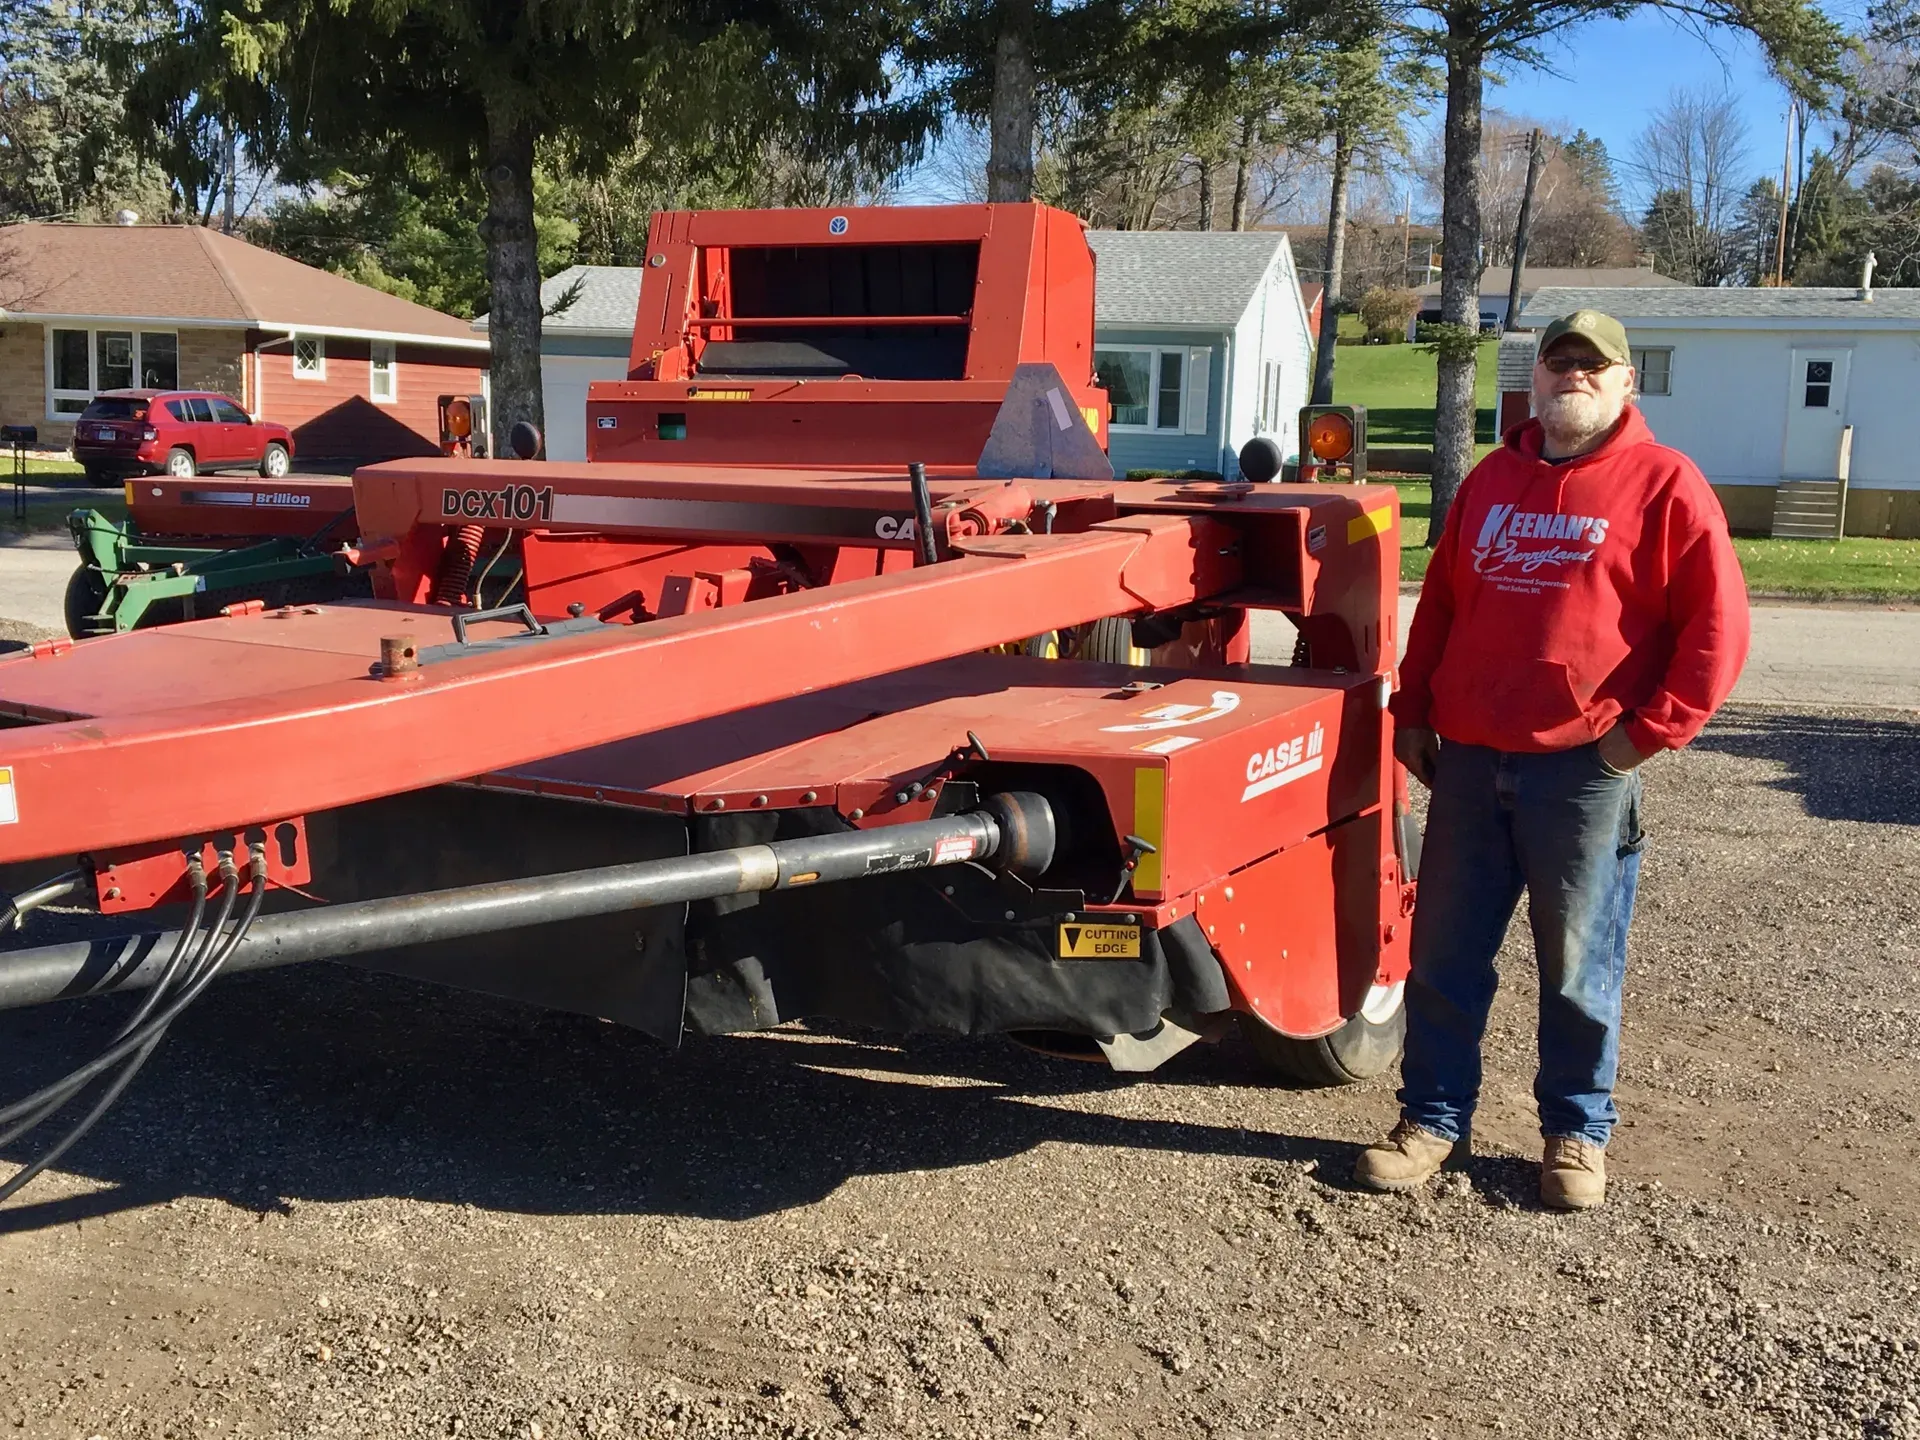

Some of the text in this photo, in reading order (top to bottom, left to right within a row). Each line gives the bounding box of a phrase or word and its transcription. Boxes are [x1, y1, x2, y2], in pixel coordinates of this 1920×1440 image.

[255, 492, 311, 505] Brillion
[442, 484, 553, 522] DCX101
[1476, 503, 1609, 548] KEENAN'S
[1471, 539, 1596, 574] Cherryland
[1535, 578, 1571, 589] Superstore
[1246, 735, 1304, 782] CASE
[1084, 929, 1138, 940] CUTTING
[1094, 943, 1129, 954] EDGE
